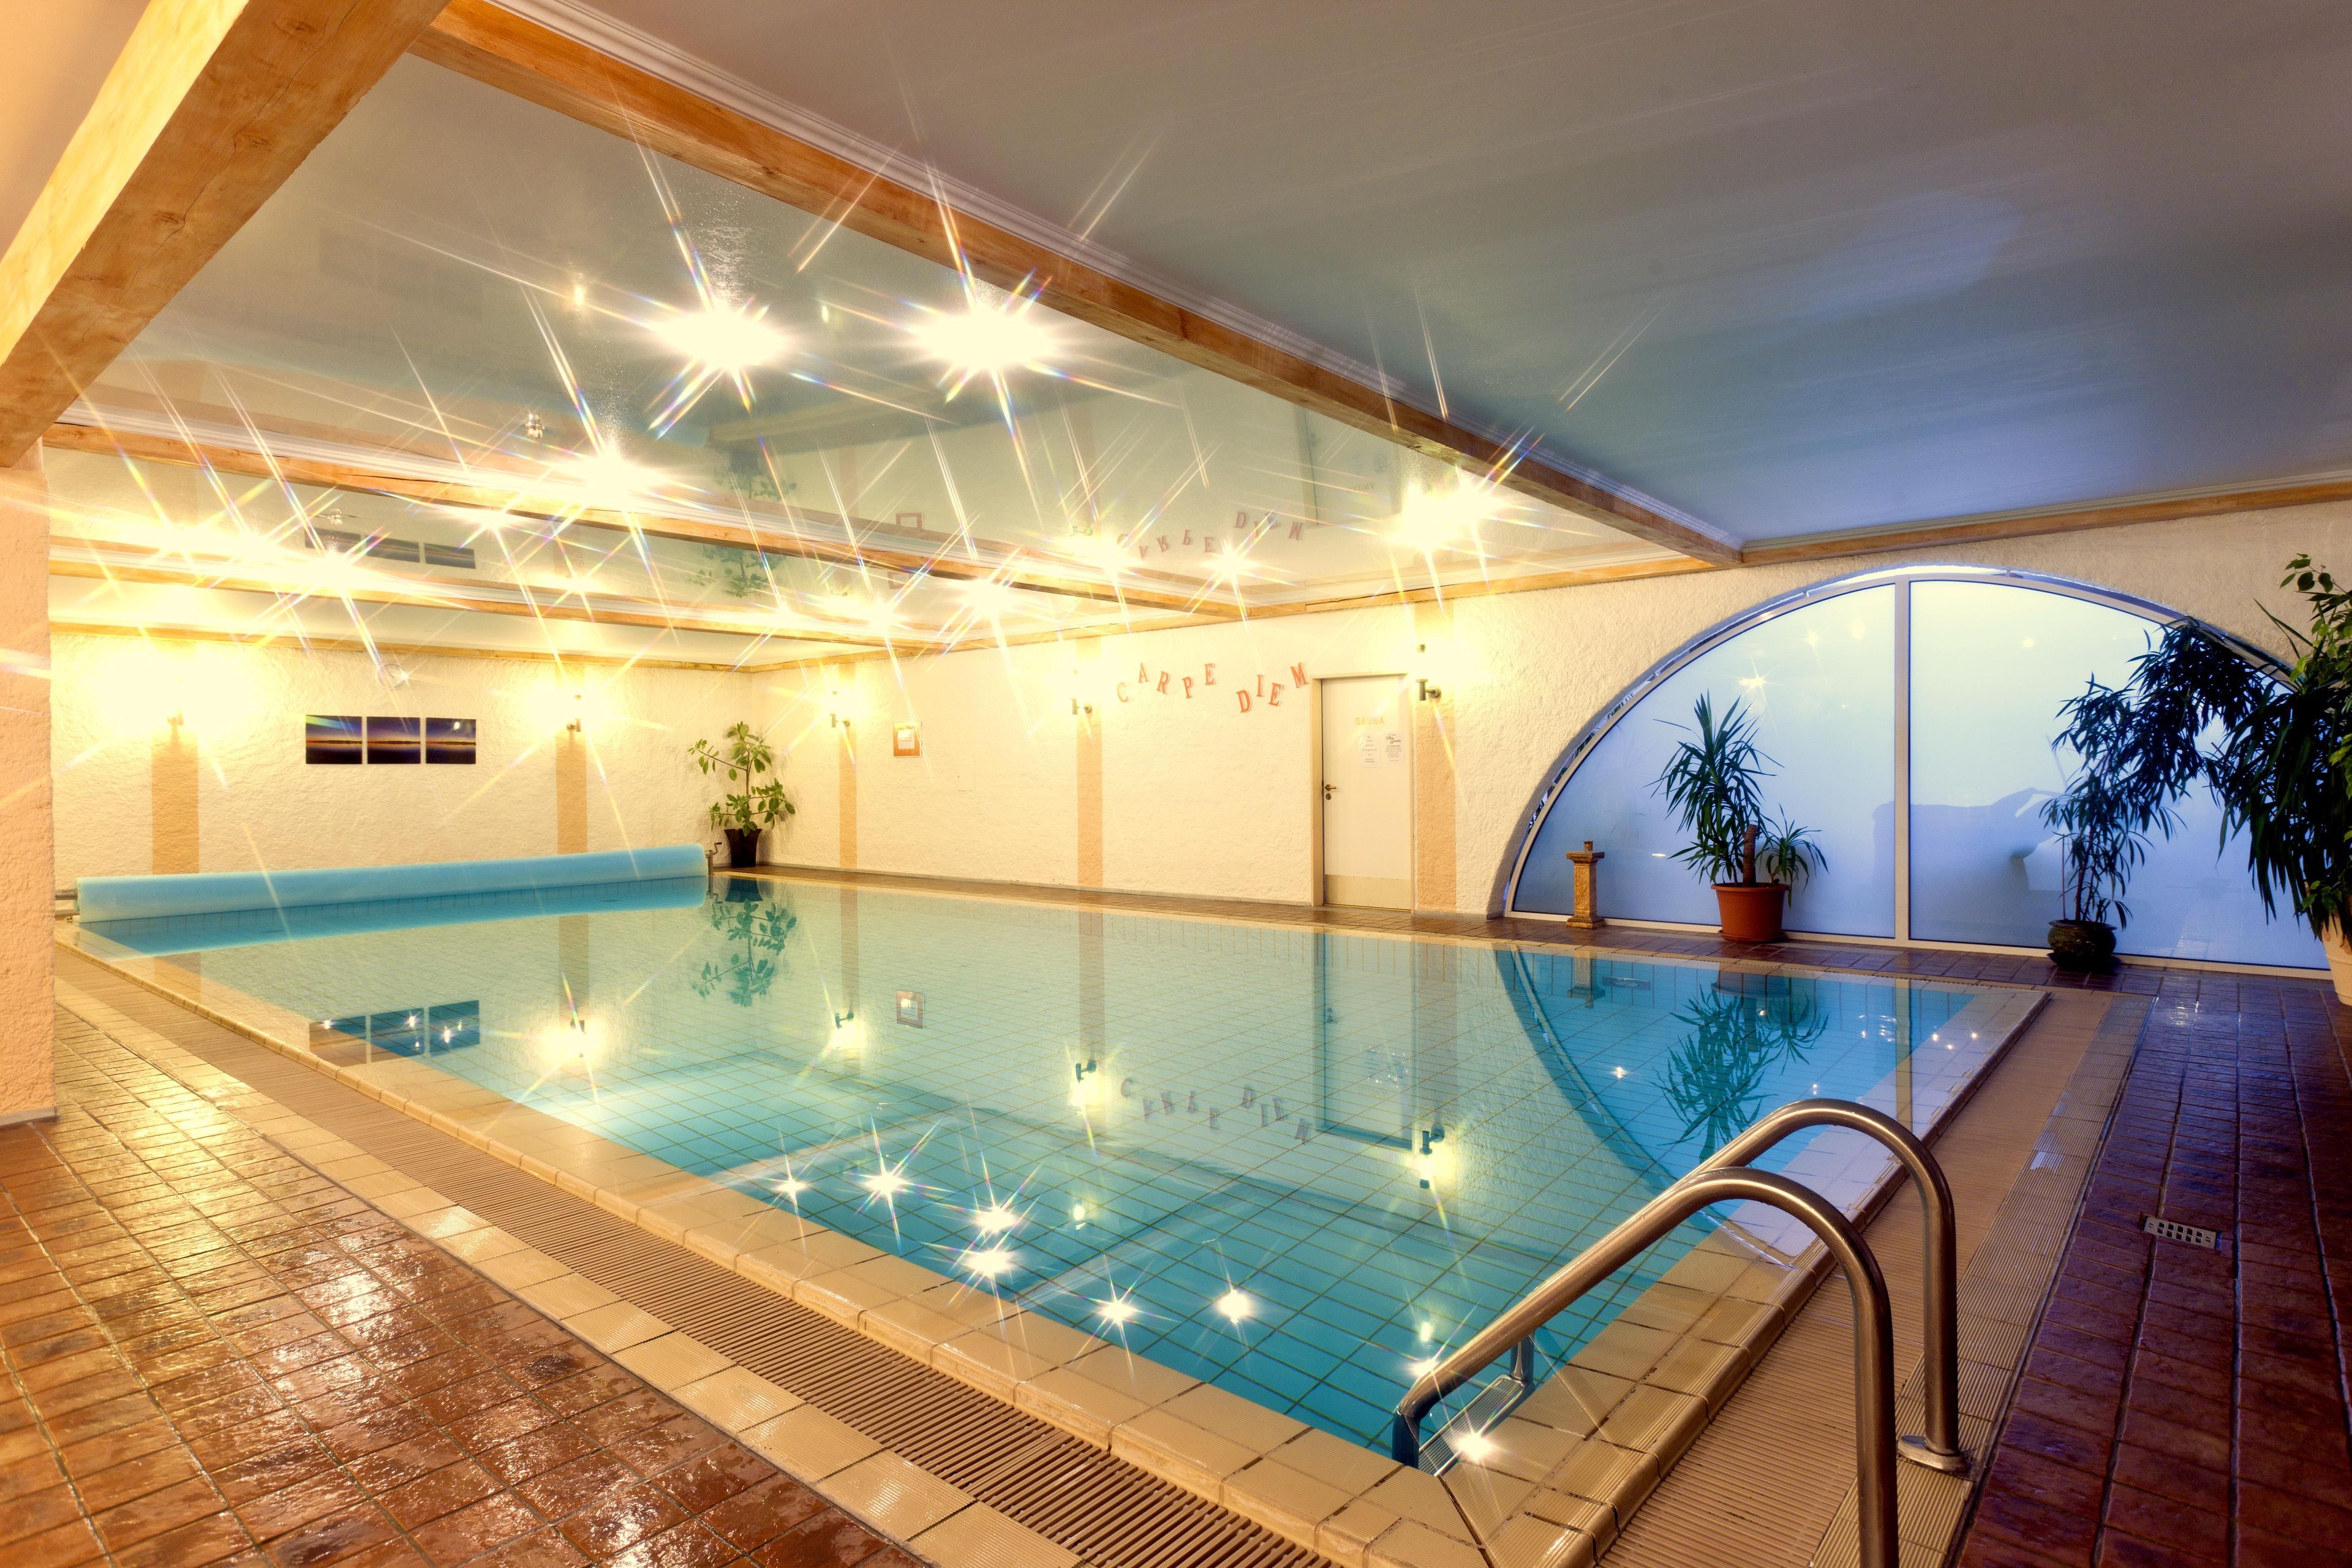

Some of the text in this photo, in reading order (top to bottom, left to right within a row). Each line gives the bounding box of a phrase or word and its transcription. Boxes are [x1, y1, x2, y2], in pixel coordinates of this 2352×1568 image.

[1117, 662, 1309, 713] CARPE DIEM
[1355, 716, 1385, 726] SAUNA
